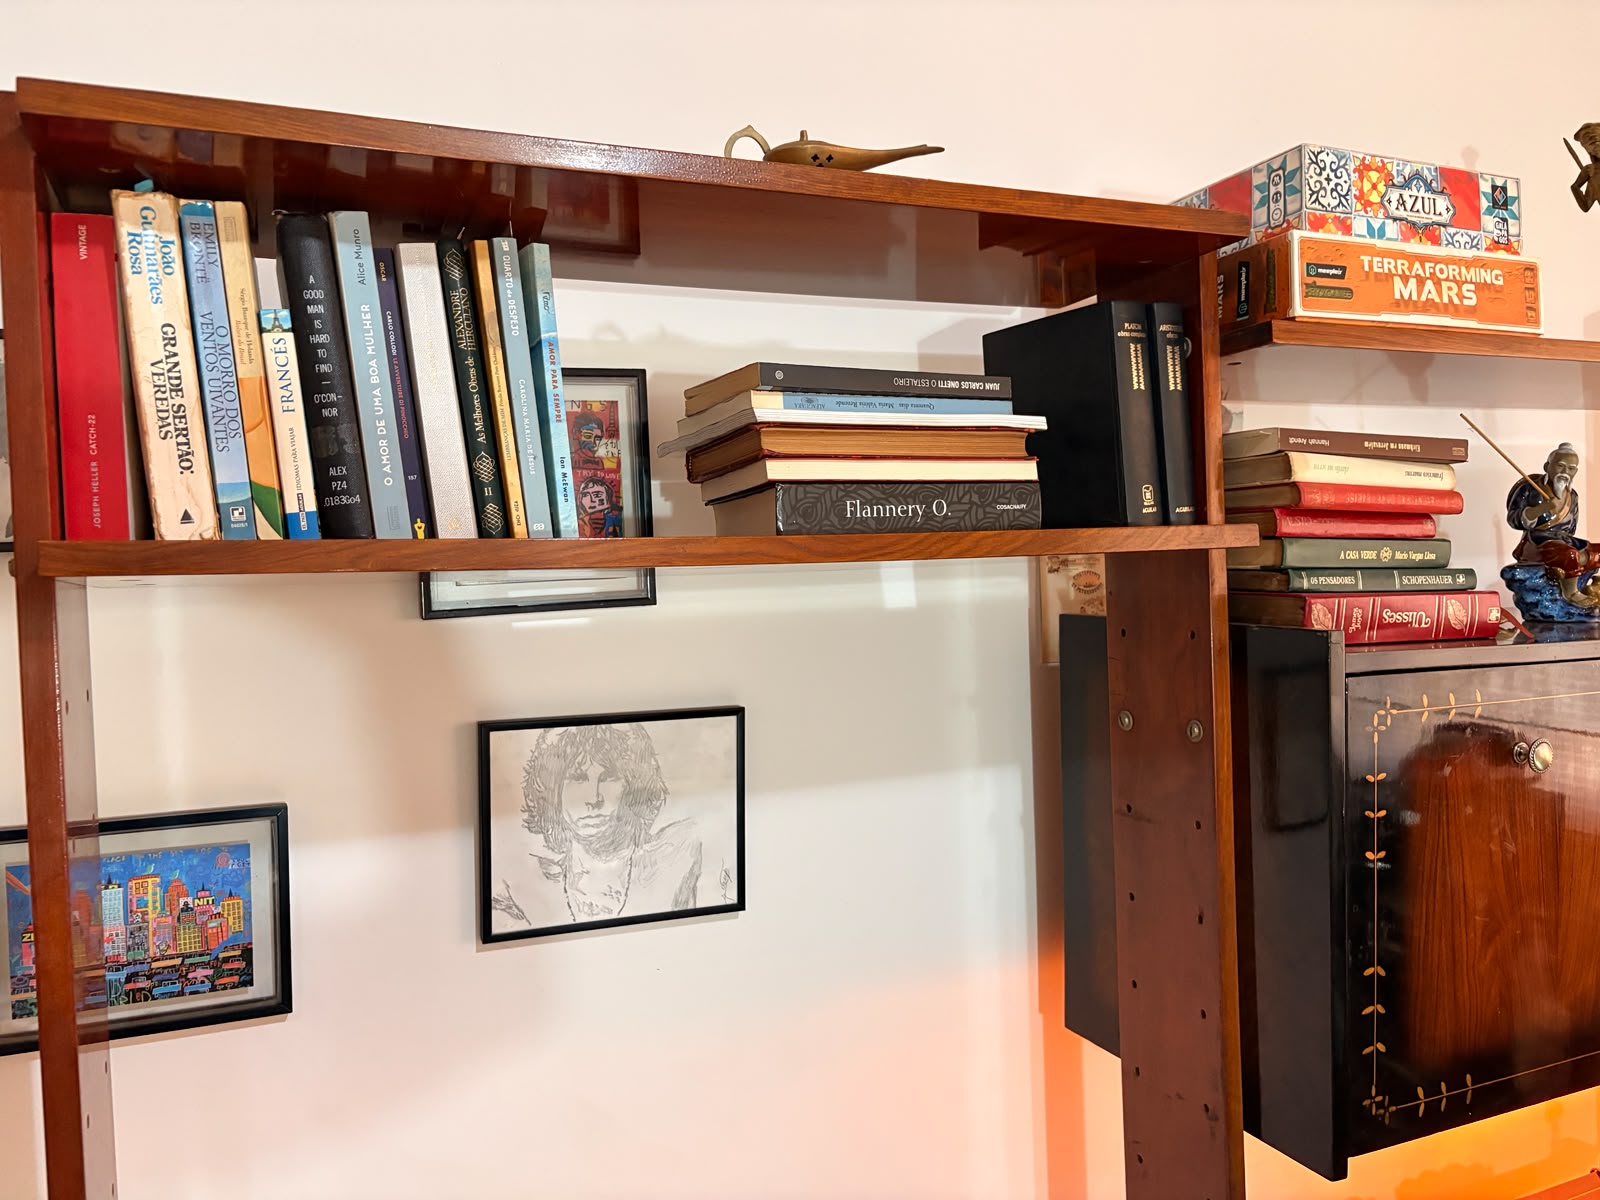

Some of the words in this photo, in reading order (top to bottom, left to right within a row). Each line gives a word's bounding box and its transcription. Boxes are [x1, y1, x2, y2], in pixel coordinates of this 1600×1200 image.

[1395, 193, 1443, 216] AZUL
[78, 224, 88, 260] VINTAGE
[127, 231, 143, 275] Rosa
[189, 221, 210, 284] BRONTË
[202, 222, 219, 268] EMILY
[352, 228, 363, 260] Munro
[139, 205, 163, 305] Guimarães
[155, 234, 176, 276] João
[309, 275, 315, 284] A
[357, 262, 367, 285] Alice
[379, 262, 387, 282] OSCAR
[502, 254, 515, 288] QUARTO
[1360, 255, 1504, 285] TERRAFORMING
[303, 290, 325, 299] GOOD
[506, 289, 513, 298] de
[1393, 276, 1477, 306] MARS
[306, 304, 325, 314] MAN
[386, 310, 394, 331] CARLO
[449, 289, 467, 350] ALEXANDRE
[459, 287, 477, 351] HERCULANO
[508, 299, 520, 336] DESPEJO
[215, 325, 229, 338] O
[245, 331, 252, 339] de
[314, 319, 323, 329] IS
[360, 303, 377, 356] MULHER
[199, 311, 220, 374] VENTOS
[309, 334, 331, 344] HARD
[389, 331, 398, 356] COLLODI
[160, 322, 184, 399] GRANDE
[246, 340, 255, 365] Holanda
[316, 349, 328, 359] TO
[392, 357, 399, 365] LE
[464, 355, 476, 367] de
[547, 341, 556, 366] AMOR
[217, 343, 237, 403] MORRO
[271, 337, 296, 414] FRANCÉS
[315, 363, 333, 373] FIND
[368, 358, 380, 384] BOA
[550, 369, 559, 390] PARA
[393, 365, 404, 400] AVVENTURE
[468, 367, 480, 393] Obras
[893, 377, 930, 388] ESTALEIRO
[931, 379, 937, 388] O
[938, 379, 960, 389] ONETTI
[961, 380, 985, 390] CARLOS
[985, 382, 1001, 391] JUAN
[150, 358, 173, 441] VEREDAS
[372, 387, 384, 416] UMA
[518, 379, 529, 418] CAROLINA
[552, 392, 563, 423] SEMPRE
[858, 400, 877, 409] Valéria
[877, 401, 895, 409] Maria
[207, 378, 230, 453] UIVANTES
[226, 408, 242, 439] DOS
[322, 408, 339, 417] NOR
[400, 406, 410, 439] PINOCCHIO
[472, 394, 485, 432] Melhores
[289, 427, 297, 448] VIAJAR
[376, 419, 387, 435] DE
[476, 433, 487, 444] As
[524, 418, 533, 443] MARIA
[171, 403, 195, 475] SERTÃO:
[1288, 436, 1308, 445] Arendt
[1308, 439, 1330, 447] Hannah
[291, 447, 299, 463] PARA
[378, 439, 393, 473] AMOR
[528, 454, 536, 475] JESUS
[91, 461, 99, 492] HELLER
[293, 464, 303, 491] IDIOMAS
[329, 466, 348, 476] ALEX
[384, 477, 393, 487] O
[331, 481, 348, 491] PZ4
[484, 487, 494, 497] II
[560, 472, 569, 503] McEwan
[92, 496, 101, 528] JOSEPH
[845, 499, 927, 523] Flannery
[932, 498, 952, 517] O.
[1339, 550, 1345, 560] A
[1346, 550, 1359, 559] CASA
[1360, 550, 1377, 559] VERDE
[1394, 551, 1409, 559] Mario
[1409, 551, 1424, 562] Vargas
[1310, 576, 1318, 585] OS
[1318, 576, 1356, 585] PENSADORES
[1402, 575, 1453, 585] SCHOPENHAUER
[1382, 608, 1432, 628] Ulisses
